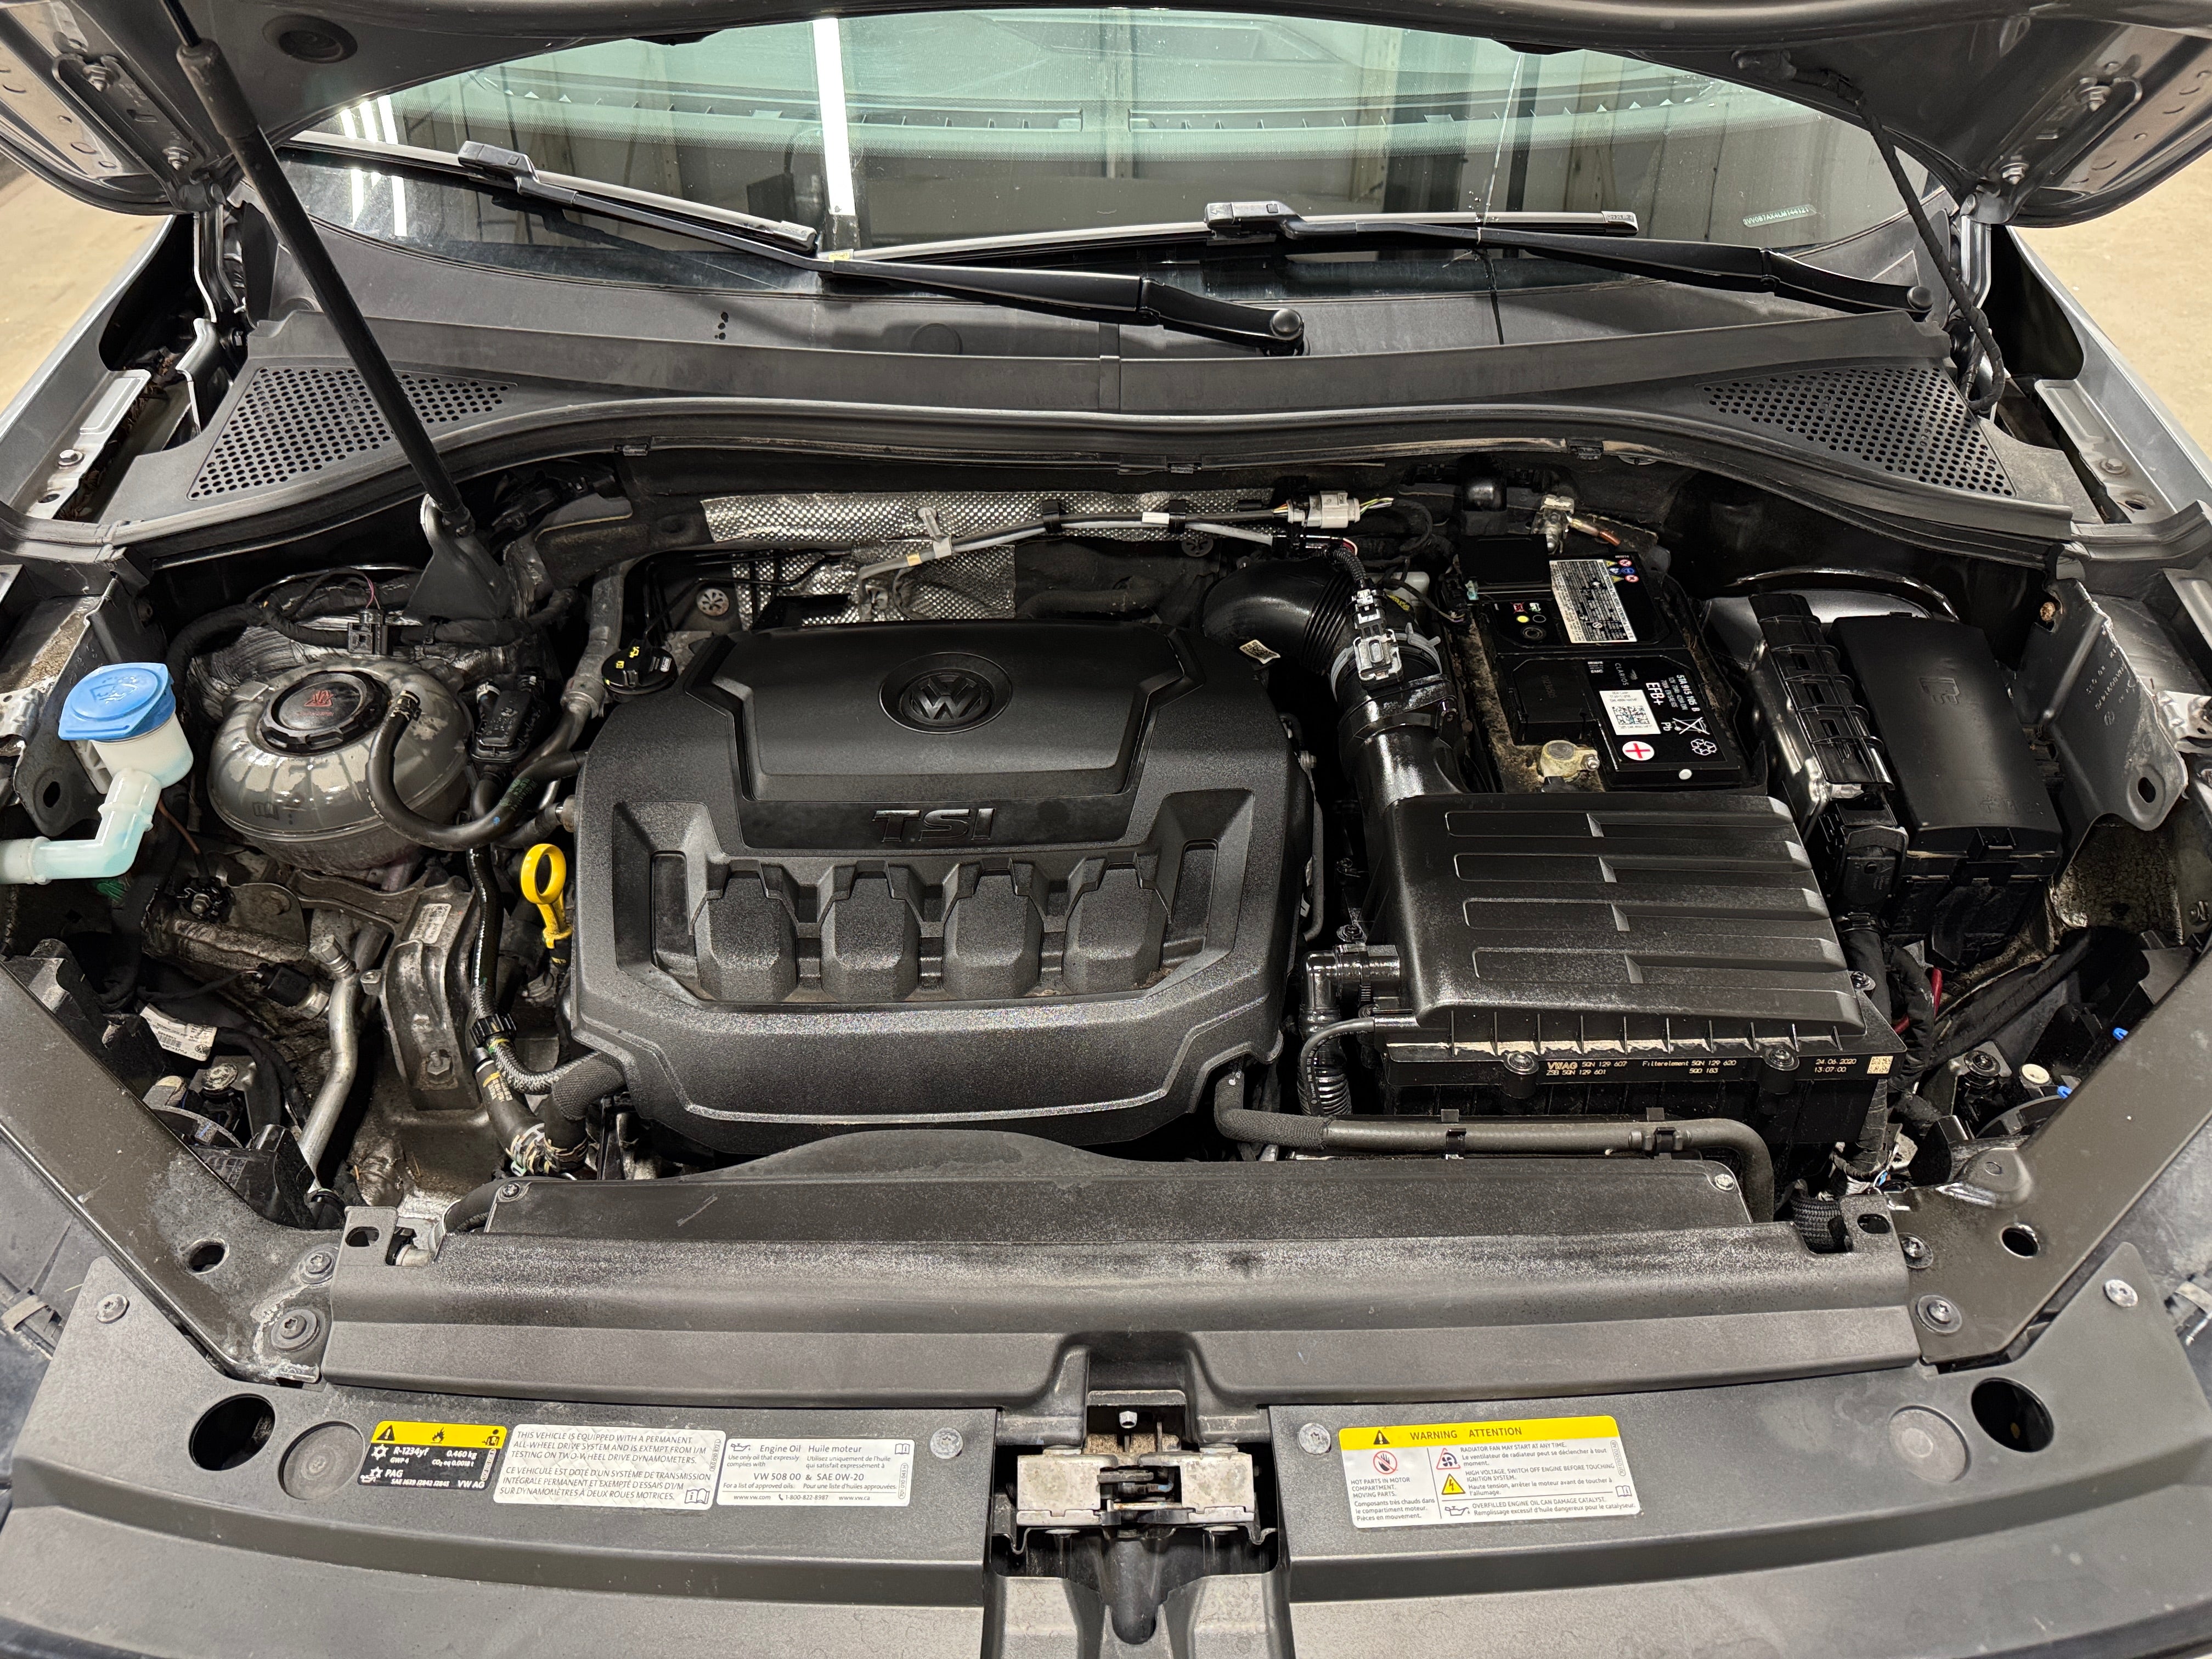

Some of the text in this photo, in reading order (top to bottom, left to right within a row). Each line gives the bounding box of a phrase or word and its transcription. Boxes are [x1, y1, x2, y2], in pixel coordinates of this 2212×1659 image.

[1615, 663, 1629, 686] CLARIOS
[1677, 675, 1688, 684] 5TA
[1646, 682, 1665, 705] EFB+
[1681, 685, 1692, 695] 915
[1686, 696, 1697, 705] 105
[1661, 722, 1672, 731] Pb
[872, 808, 996, 842] TSI
[1410, 1427, 1522, 1440] WARNING ATTENTION
[393, 1447, 430, 1457] R-1234yf
[760, 1445, 787, 1454] Engine
[559, 1452, 606, 1460] TWO-WHEEL
[632, 1455, 697, 1464] DYNAMOMETERS.
[385, 1469, 404, 1477] PAG
[517, 1466, 552, 1474] VÉHICULE
[611, 1469, 643, 1477] SYSTÈME
[656, 1472, 711, 1480] TRANSMISSION
[503, 1476, 541, 1484] INTÉGRALE
[599, 1480, 630, 1488] EXEMPTÉ
[517, 1487, 578, 1496] DYNAMOMÈTRES
[636, 1492, 675, 1500] MOTRICES.
